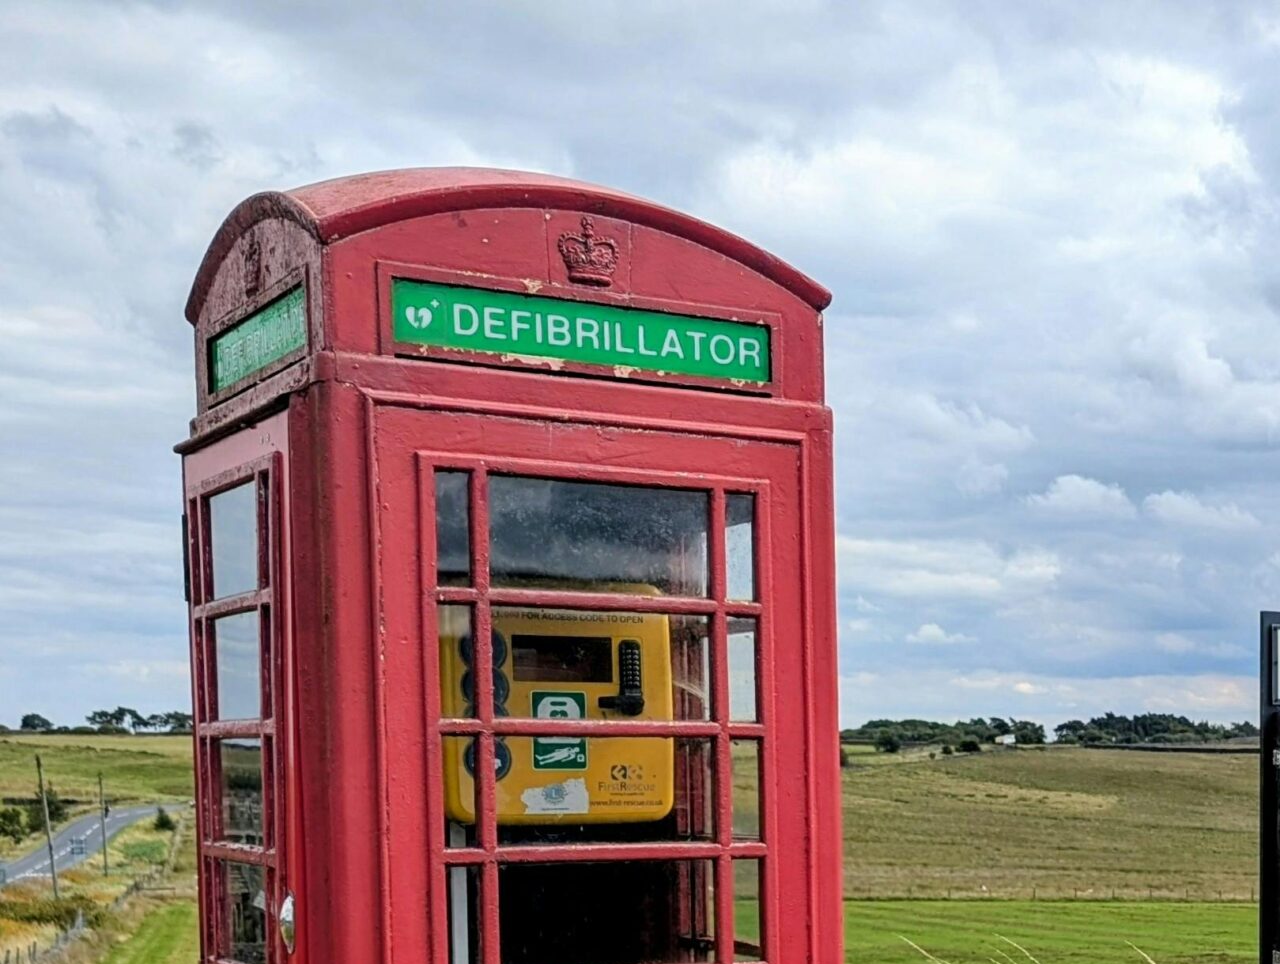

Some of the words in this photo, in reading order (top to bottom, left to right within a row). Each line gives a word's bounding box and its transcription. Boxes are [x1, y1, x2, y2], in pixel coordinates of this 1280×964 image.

[452, 302, 762, 370] DEFIBRILLATOR
[521, 611, 540, 620] FOR
[542, 612, 578, 621] ACCESS
[579, 614, 604, 622] CODE
[605, 615, 617, 623] TO
[619, 615, 643, 624] OPEN
